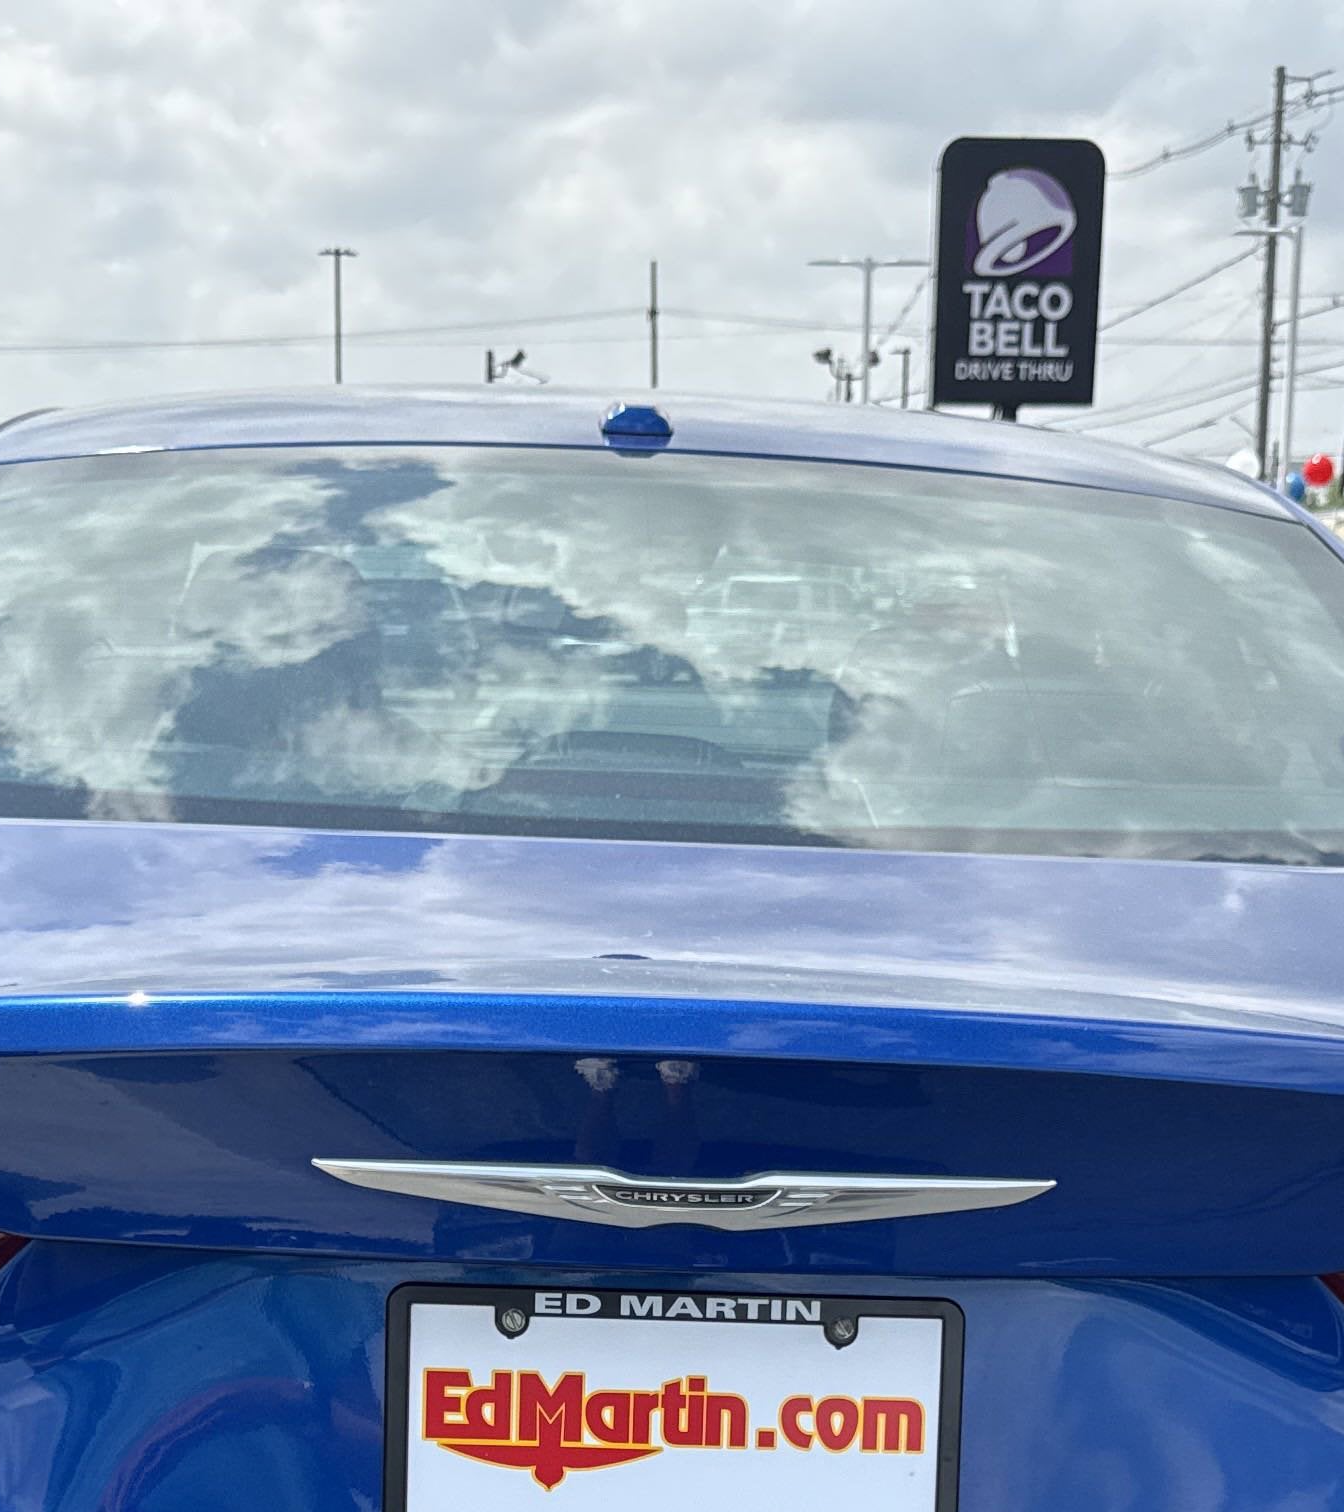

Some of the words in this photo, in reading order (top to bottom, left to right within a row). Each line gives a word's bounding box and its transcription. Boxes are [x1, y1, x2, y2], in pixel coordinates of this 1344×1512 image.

[962, 281, 1074, 321] TACO
[968, 321, 1071, 358] BELL
[955, 361, 1016, 381] DRIVE
[1018, 361, 1075, 382] THRU
[615, 1190, 754, 1204] CHRYSLER
[534, 1292, 603, 1316] ED
[619, 1295, 822, 1322] MARTIN
[422, 1366, 926, 1455] EdMartin.com
